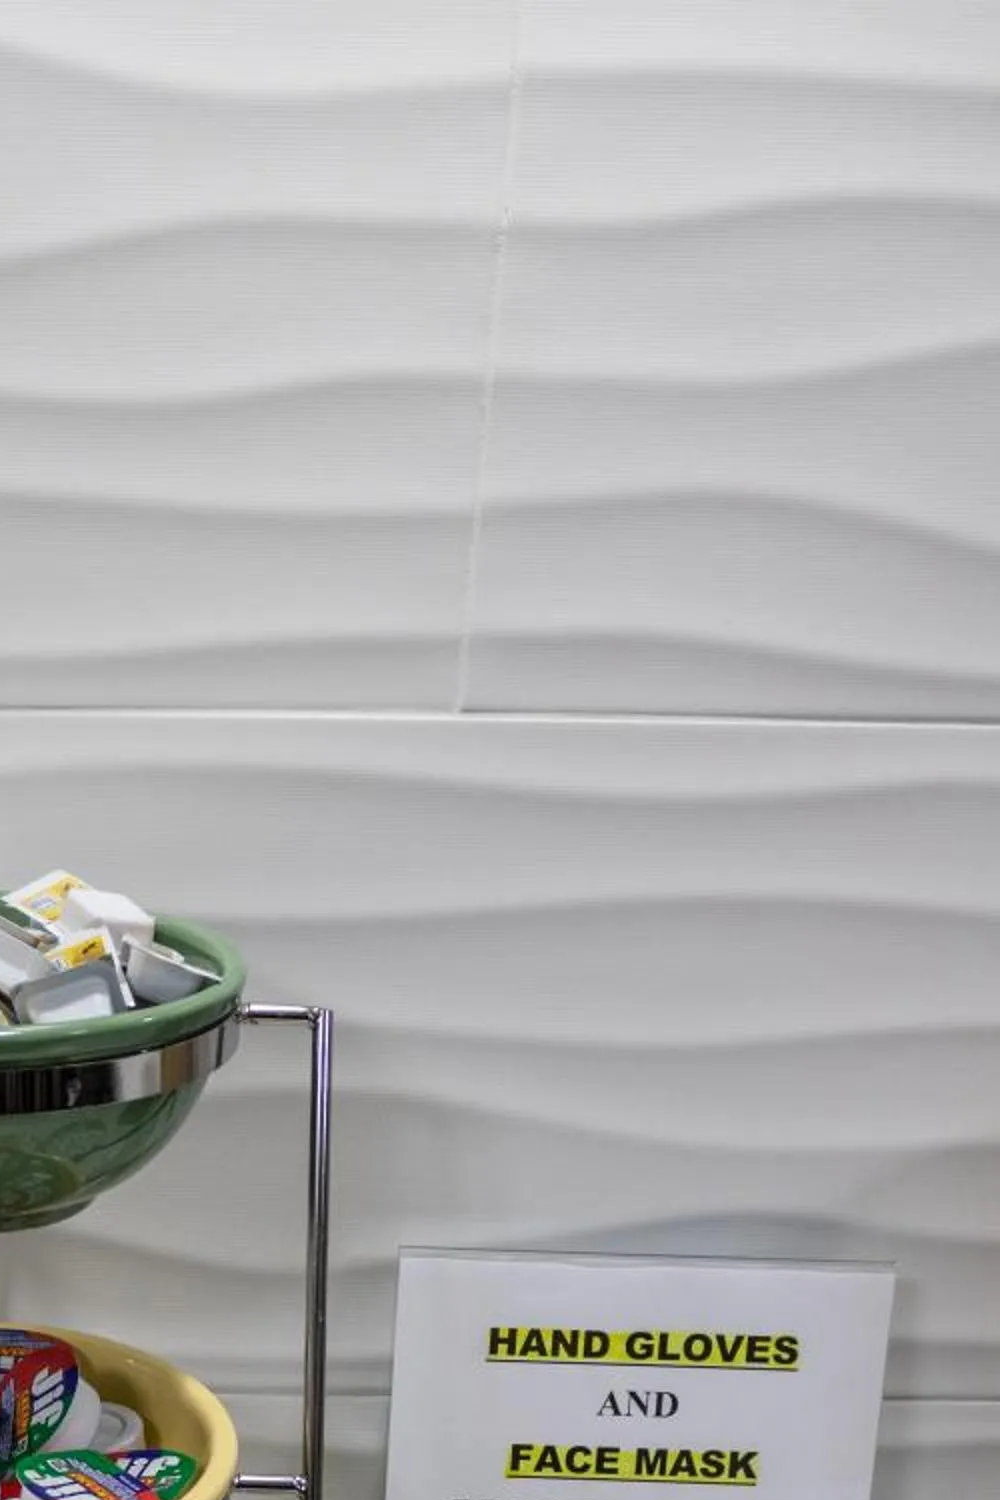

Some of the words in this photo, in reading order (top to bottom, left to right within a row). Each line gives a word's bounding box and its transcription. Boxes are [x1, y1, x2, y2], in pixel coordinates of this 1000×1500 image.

[487, 1326, 610, 1360] HAND
[624, 1330, 799, 1365] GLOVES
[597, 1390, 680, 1419] AND
[509, 1443, 620, 1476] FACE
[634, 1448, 759, 1480] MASK
